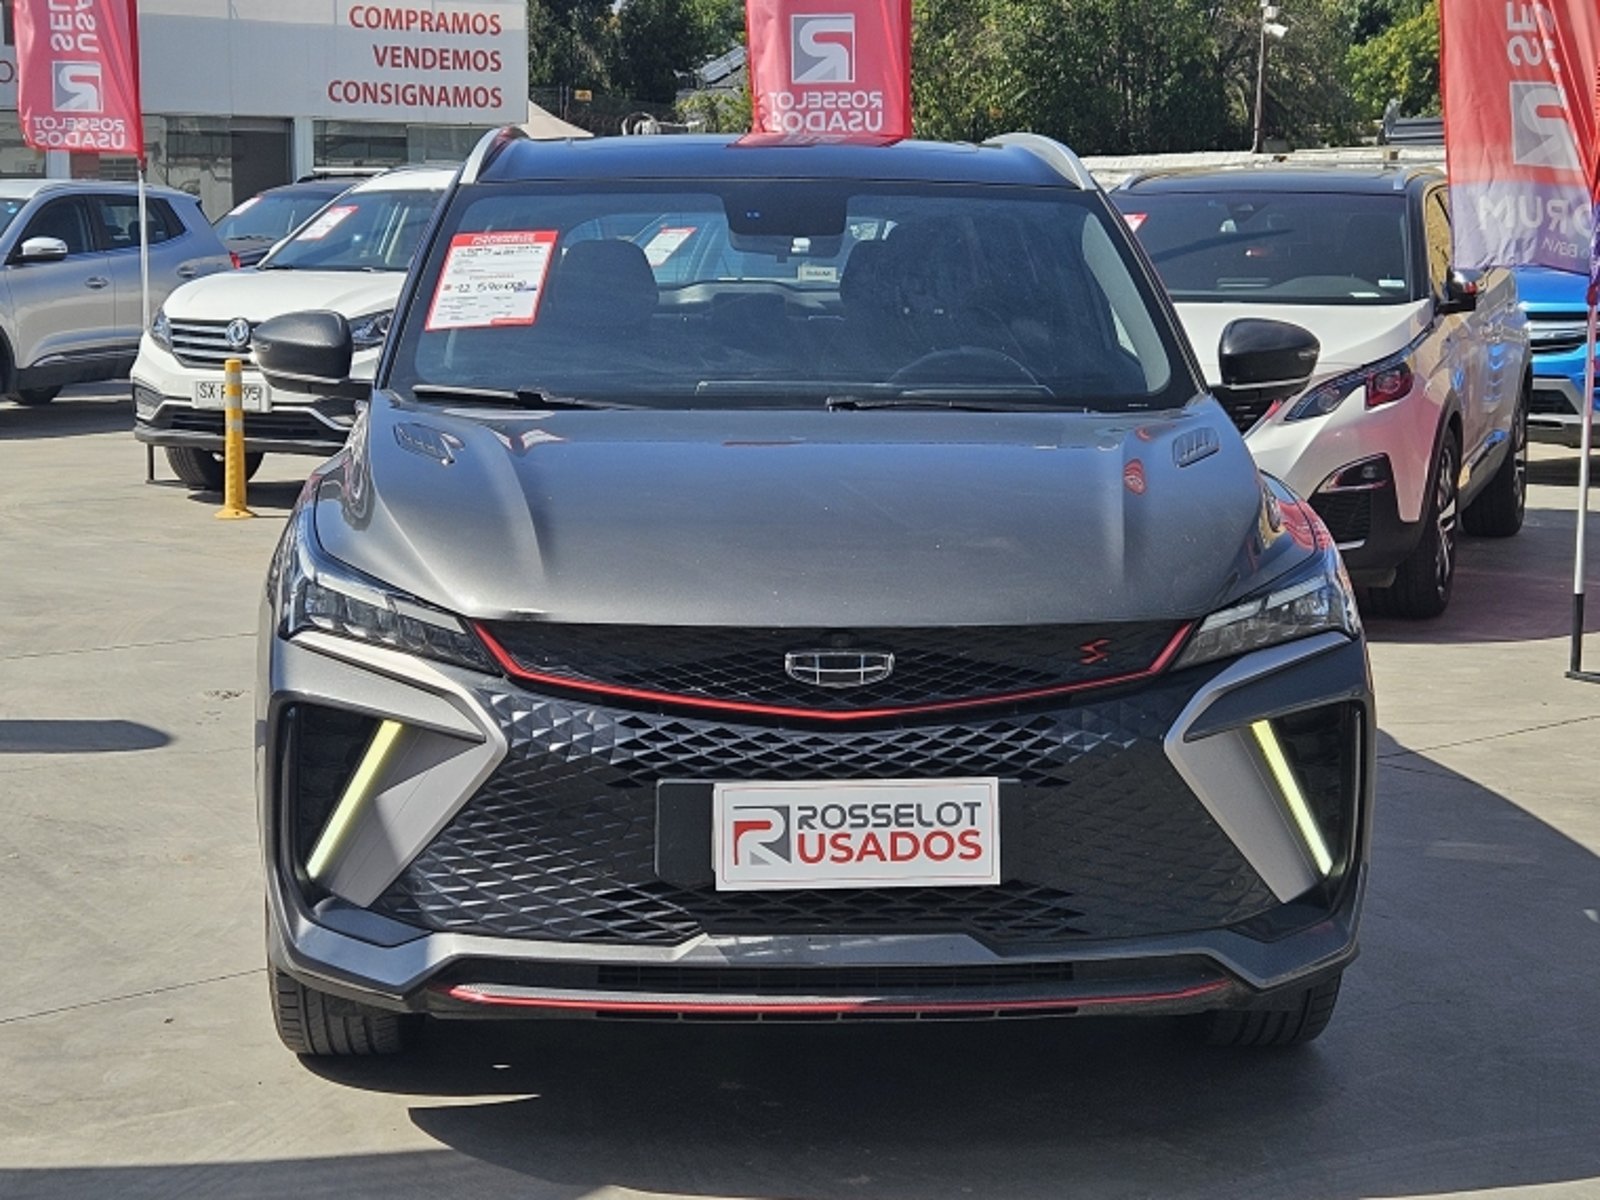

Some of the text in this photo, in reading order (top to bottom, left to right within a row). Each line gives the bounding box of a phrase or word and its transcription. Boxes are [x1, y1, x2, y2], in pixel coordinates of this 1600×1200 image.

[350, 5, 502, 36] COMPRAMOS
[373, 44, 502, 72] VENDEMOS
[328, 80, 502, 108] CONSIGNAMOS
[797, 802, 982, 830] ROSSELOT
[797, 829, 983, 864] USADOS
